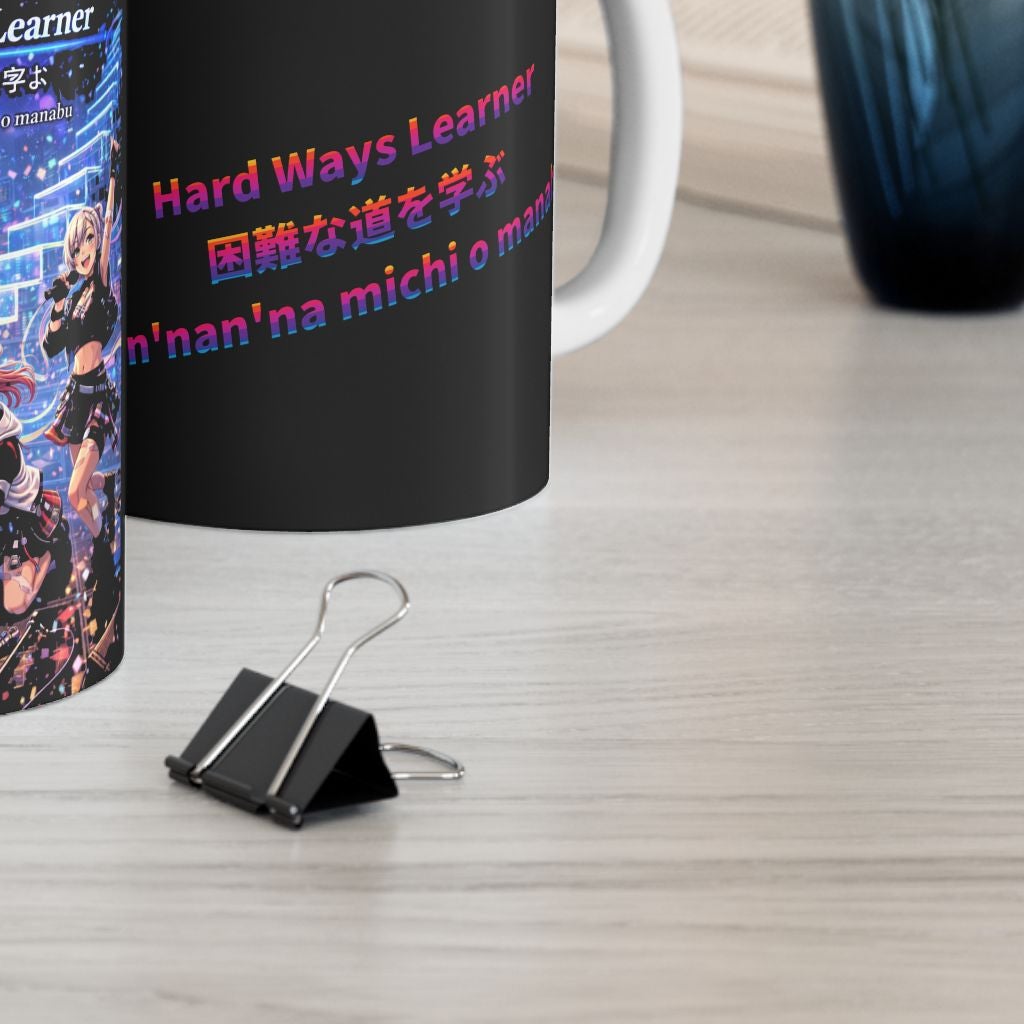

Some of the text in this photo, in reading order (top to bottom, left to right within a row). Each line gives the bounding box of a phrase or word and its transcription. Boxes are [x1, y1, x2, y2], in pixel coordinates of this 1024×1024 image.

[0, 116, 11, 128] o
[14, 103, 73, 127] manabu
[152, 63, 535, 219] Hard Ways Learner
[207, 149, 506, 284] 困難な道を学ぶ
[340, 240, 459, 320] michi
[469, 240, 489, 270] o
